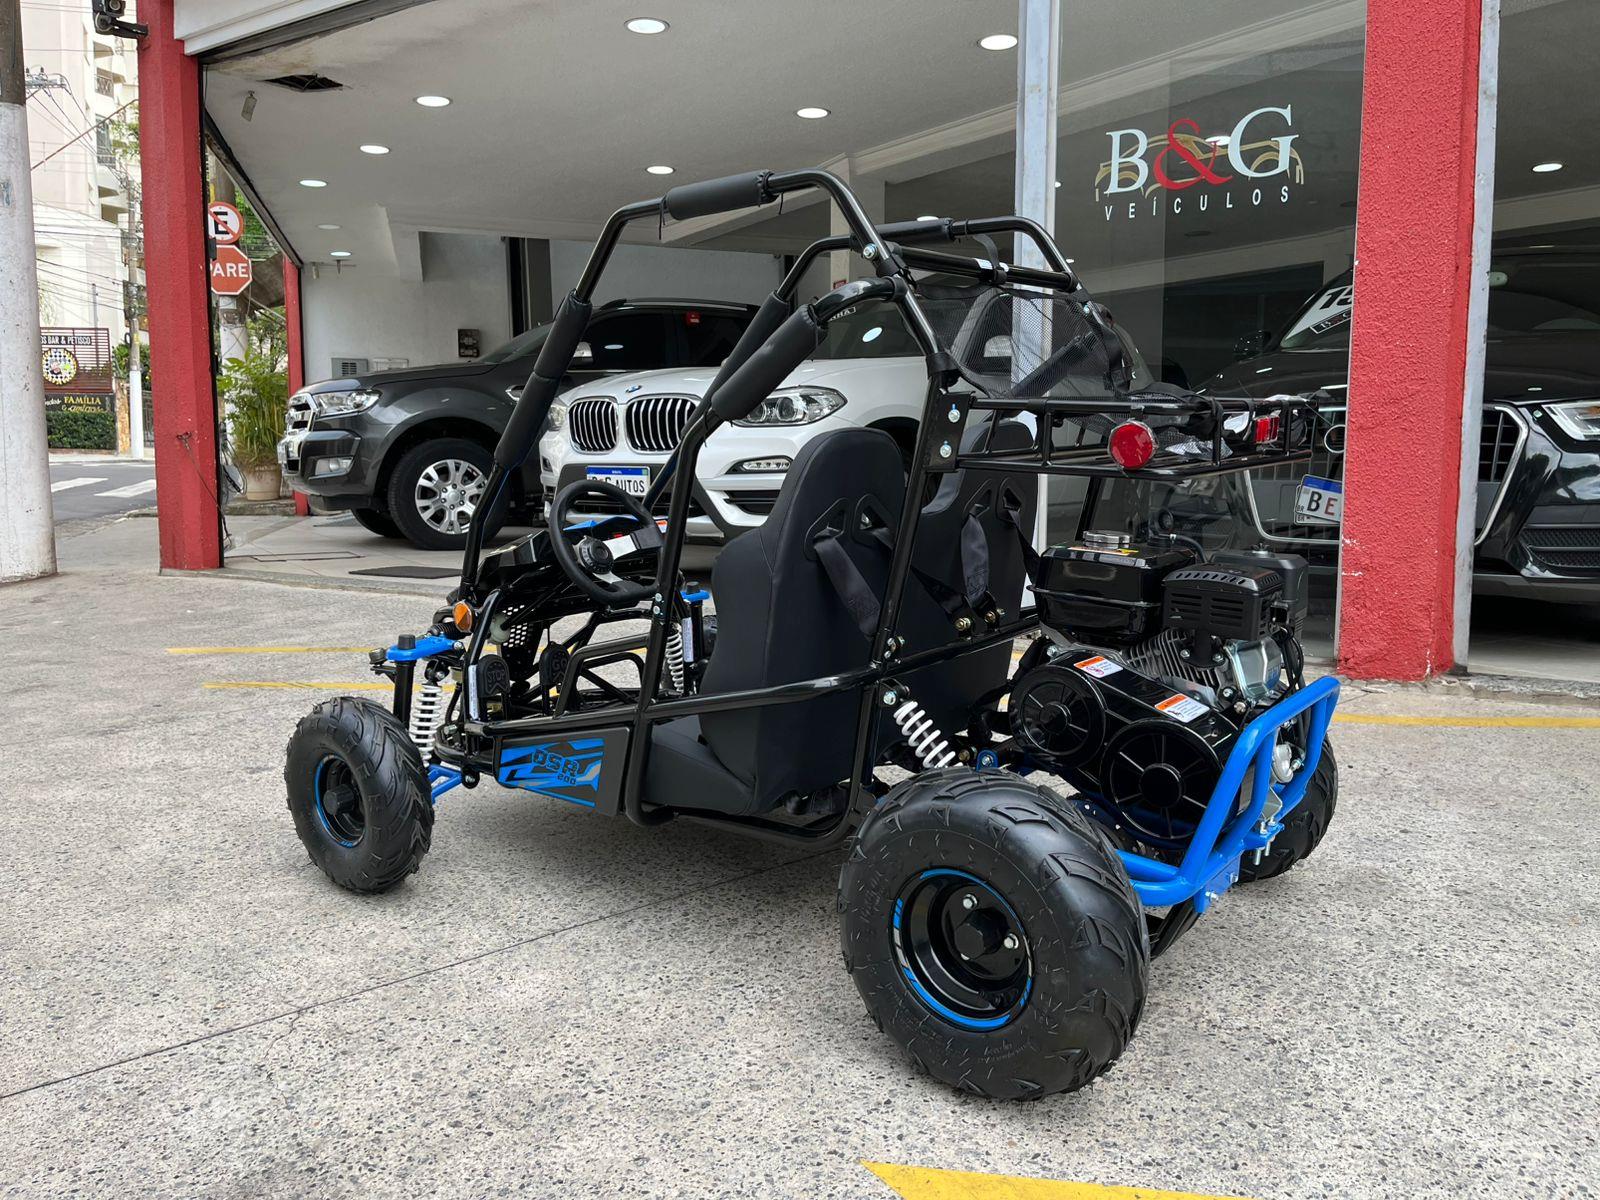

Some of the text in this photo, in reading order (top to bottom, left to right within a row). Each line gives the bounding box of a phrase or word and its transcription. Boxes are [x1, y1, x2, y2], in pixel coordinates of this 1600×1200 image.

[1103, 104, 1300, 195] B&G
[1104, 185, 1290, 221] VEÍCULOS
[213, 211, 230, 235] E
[210, 262, 249, 278] ARE
[64, 395, 101, 404] FAMÍLIA
[616, 480, 645, 493] AUTOS
